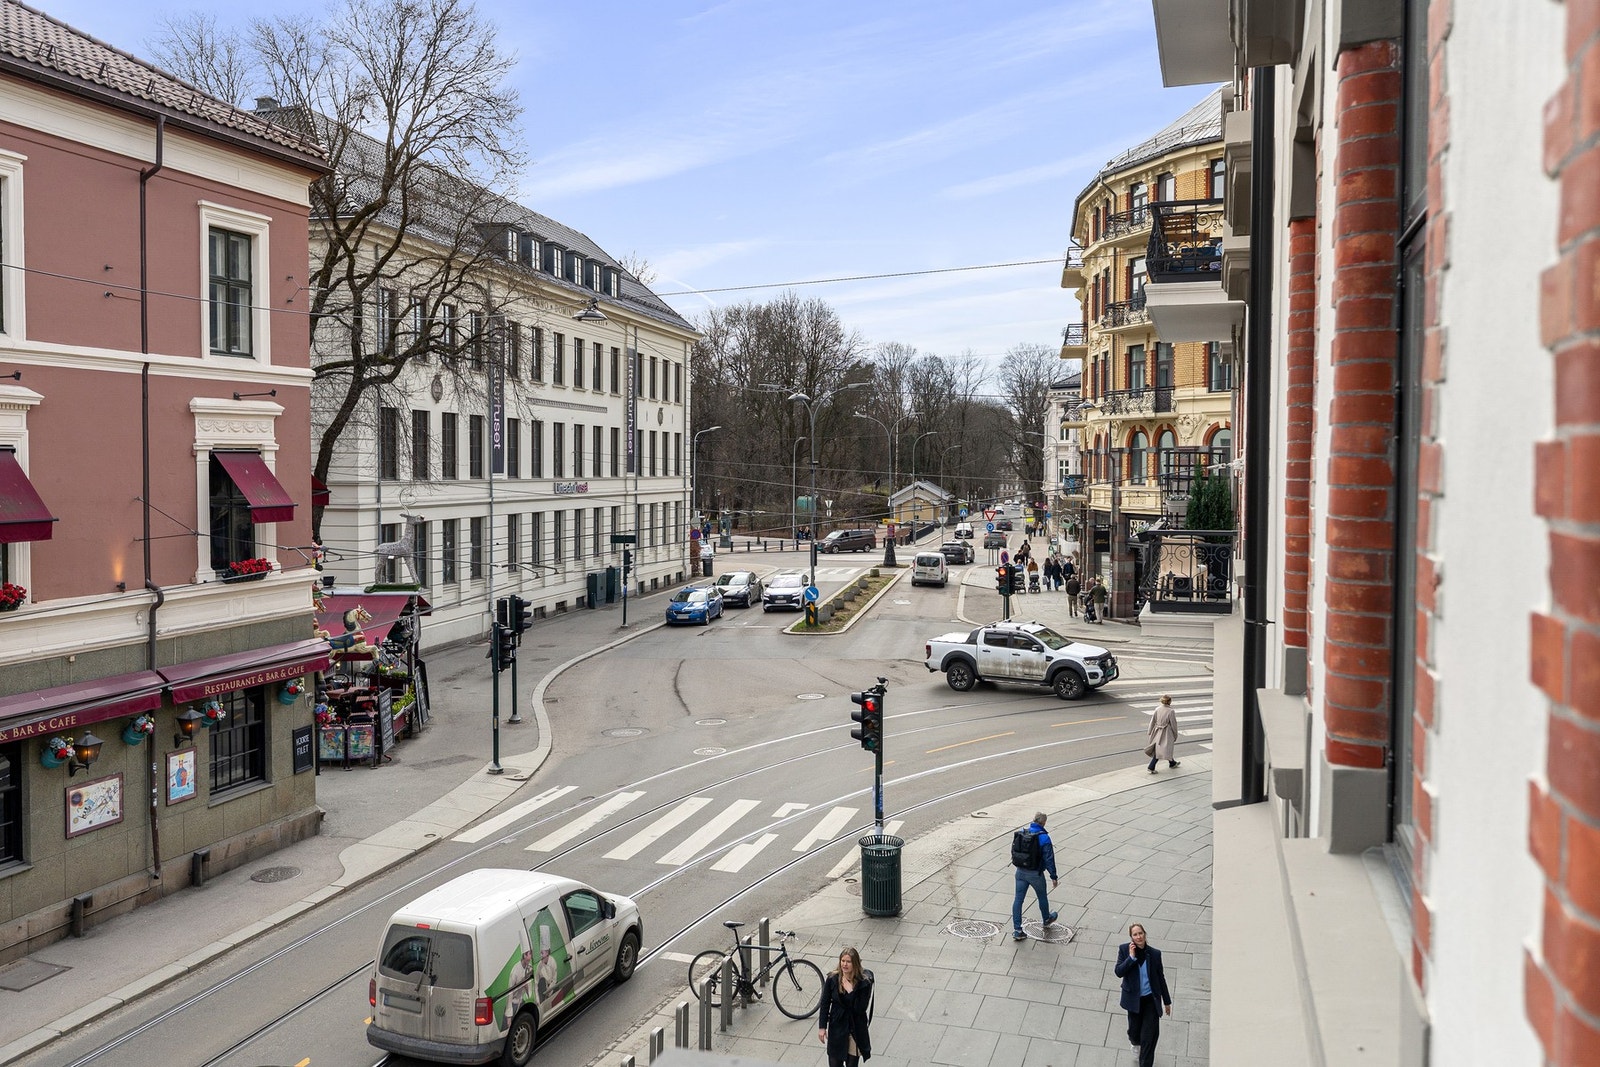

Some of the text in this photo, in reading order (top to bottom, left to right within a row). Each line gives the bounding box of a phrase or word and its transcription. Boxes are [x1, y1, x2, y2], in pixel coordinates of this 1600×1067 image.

[204, 665, 305, 695] RESTAURANT & BAR & CAFE
[12, 725, 35, 738] BAR
[38, 721, 47, 732] &
[49, 715, 77, 729] CAFE
